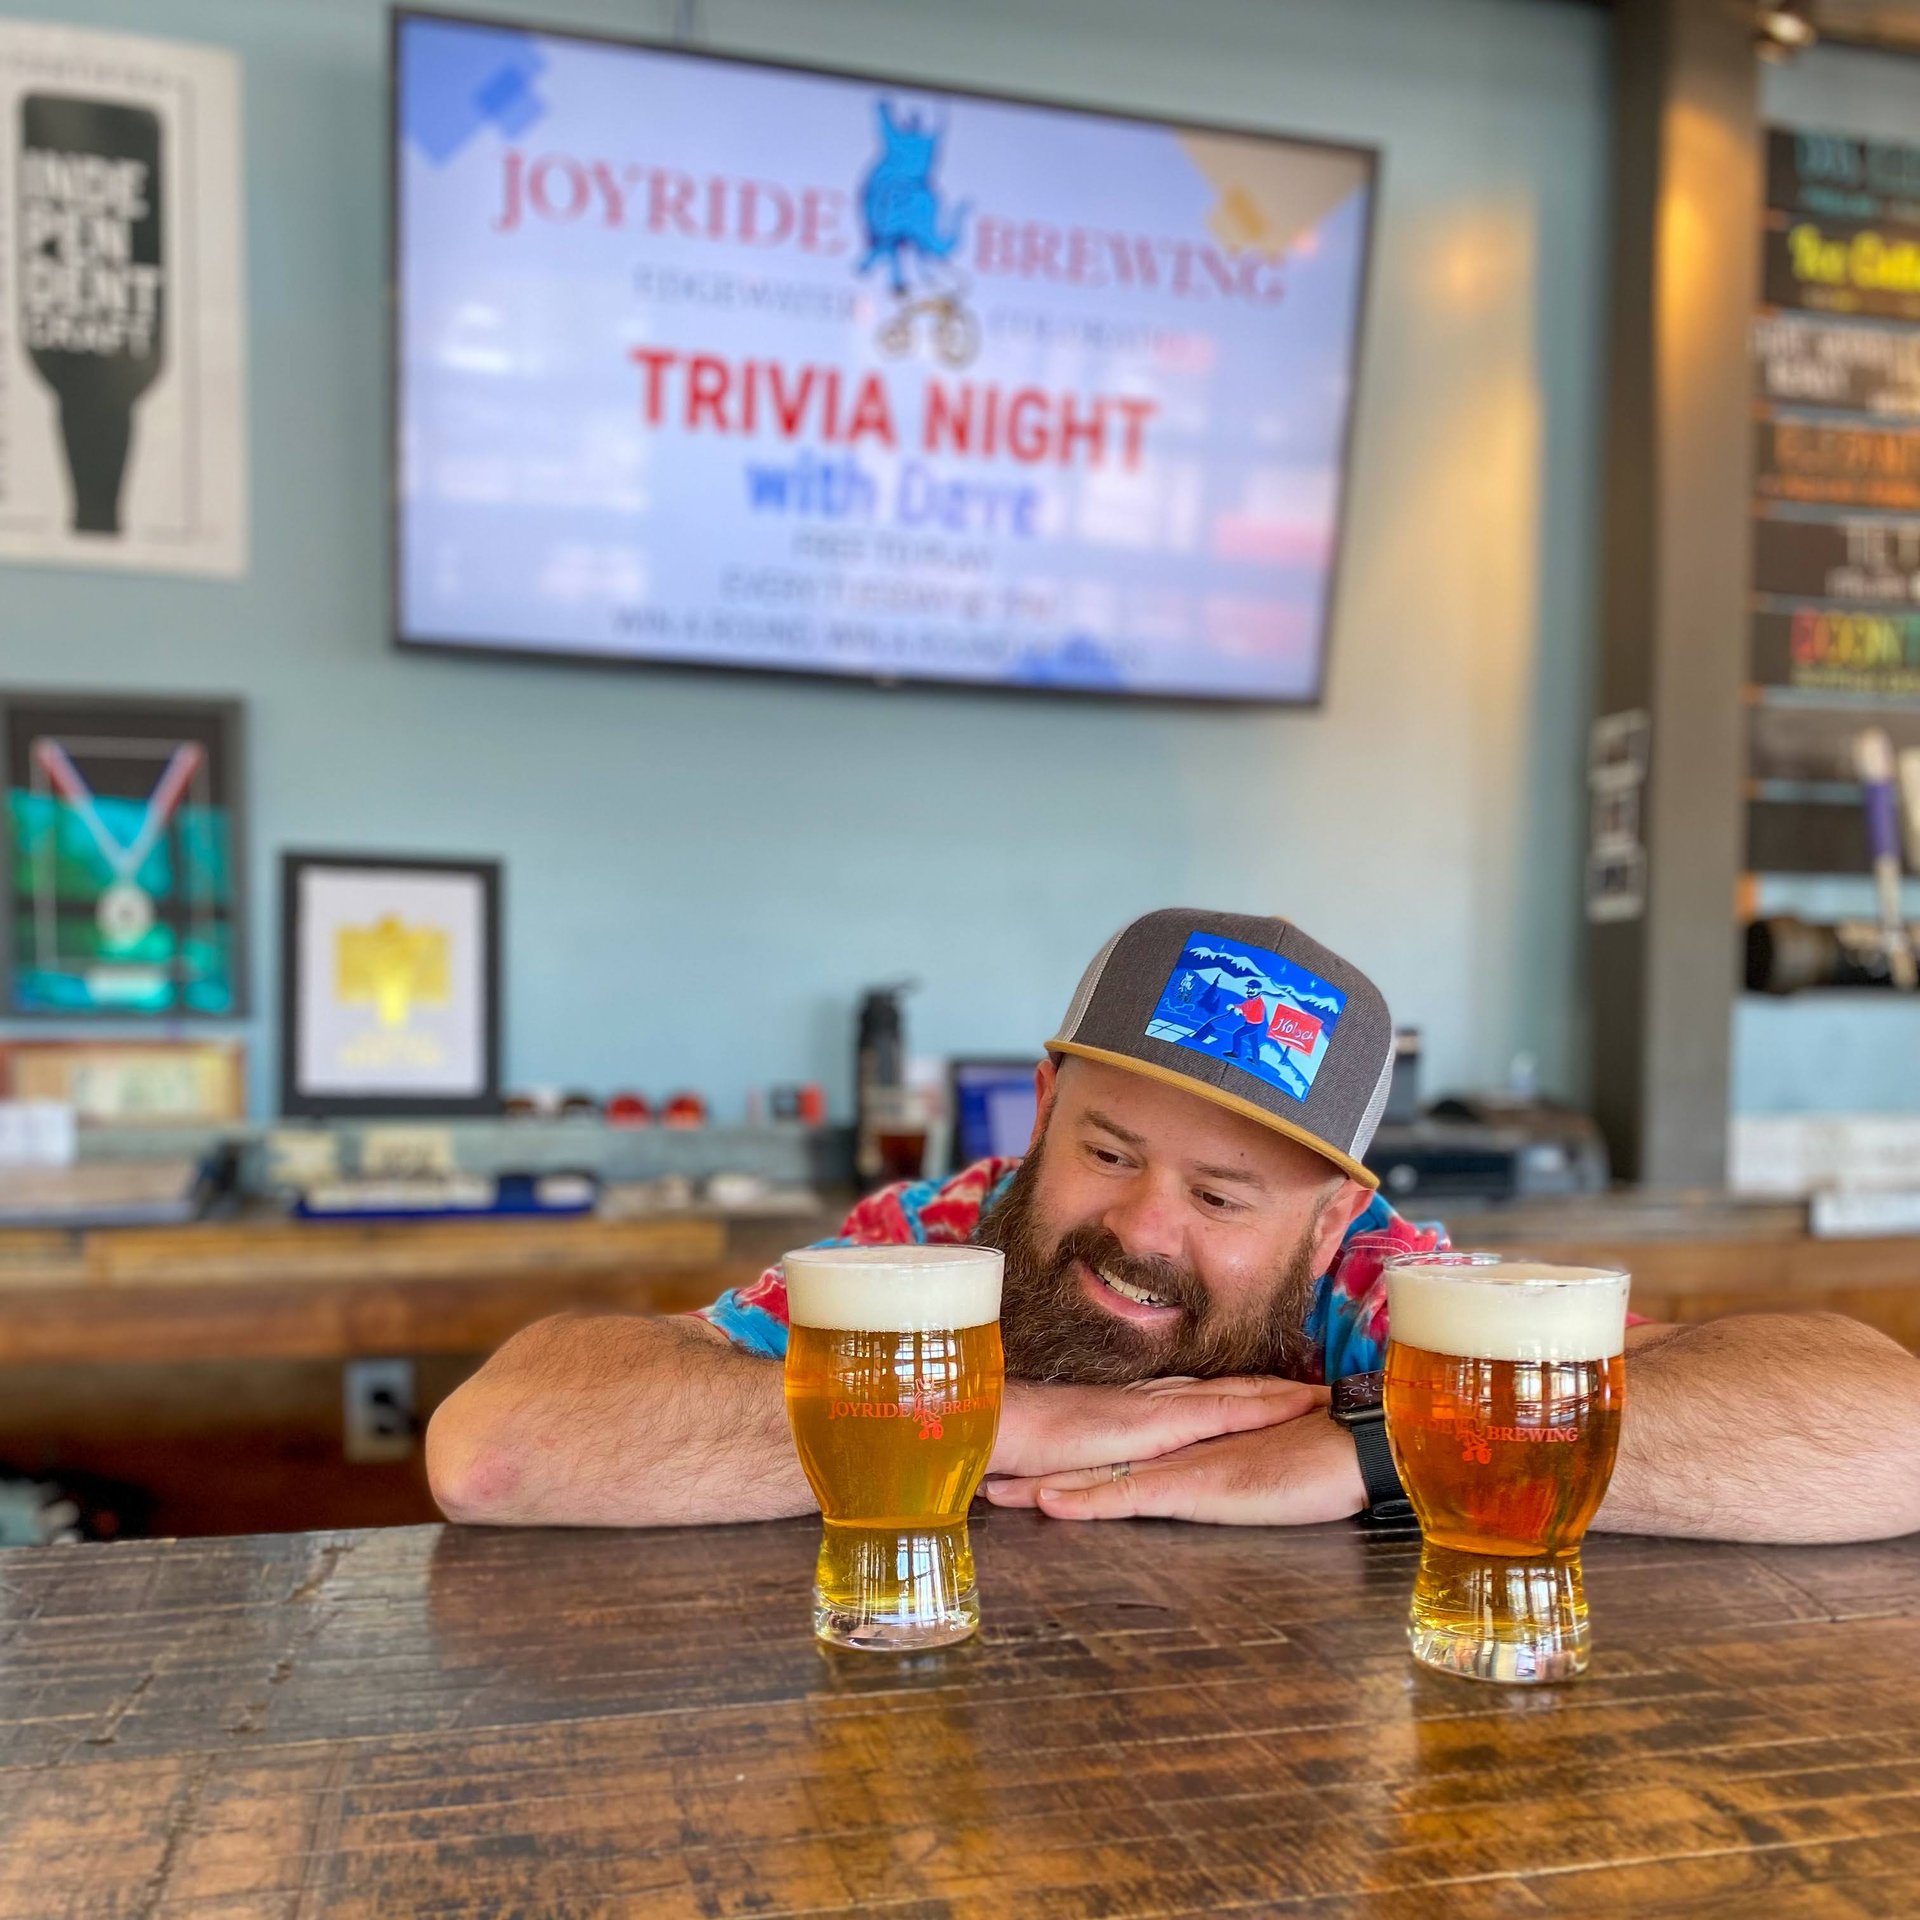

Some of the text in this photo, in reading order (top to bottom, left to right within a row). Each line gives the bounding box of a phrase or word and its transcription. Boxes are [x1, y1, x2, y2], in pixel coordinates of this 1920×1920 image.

[20, 148, 150, 221] INDE
[24, 202, 133, 268] PEN
[492, 149, 1288, 308] JOYRIDE BREWING
[27, 257, 162, 318] DENT
[630, 345, 1158, 473] TRIVIA NIGHT
[745, 449, 1040, 540] with Dave
[828, 1396, 998, 1420] JOYRIDE BREWIN
[1486, 1425, 1579, 1443] BREWING
